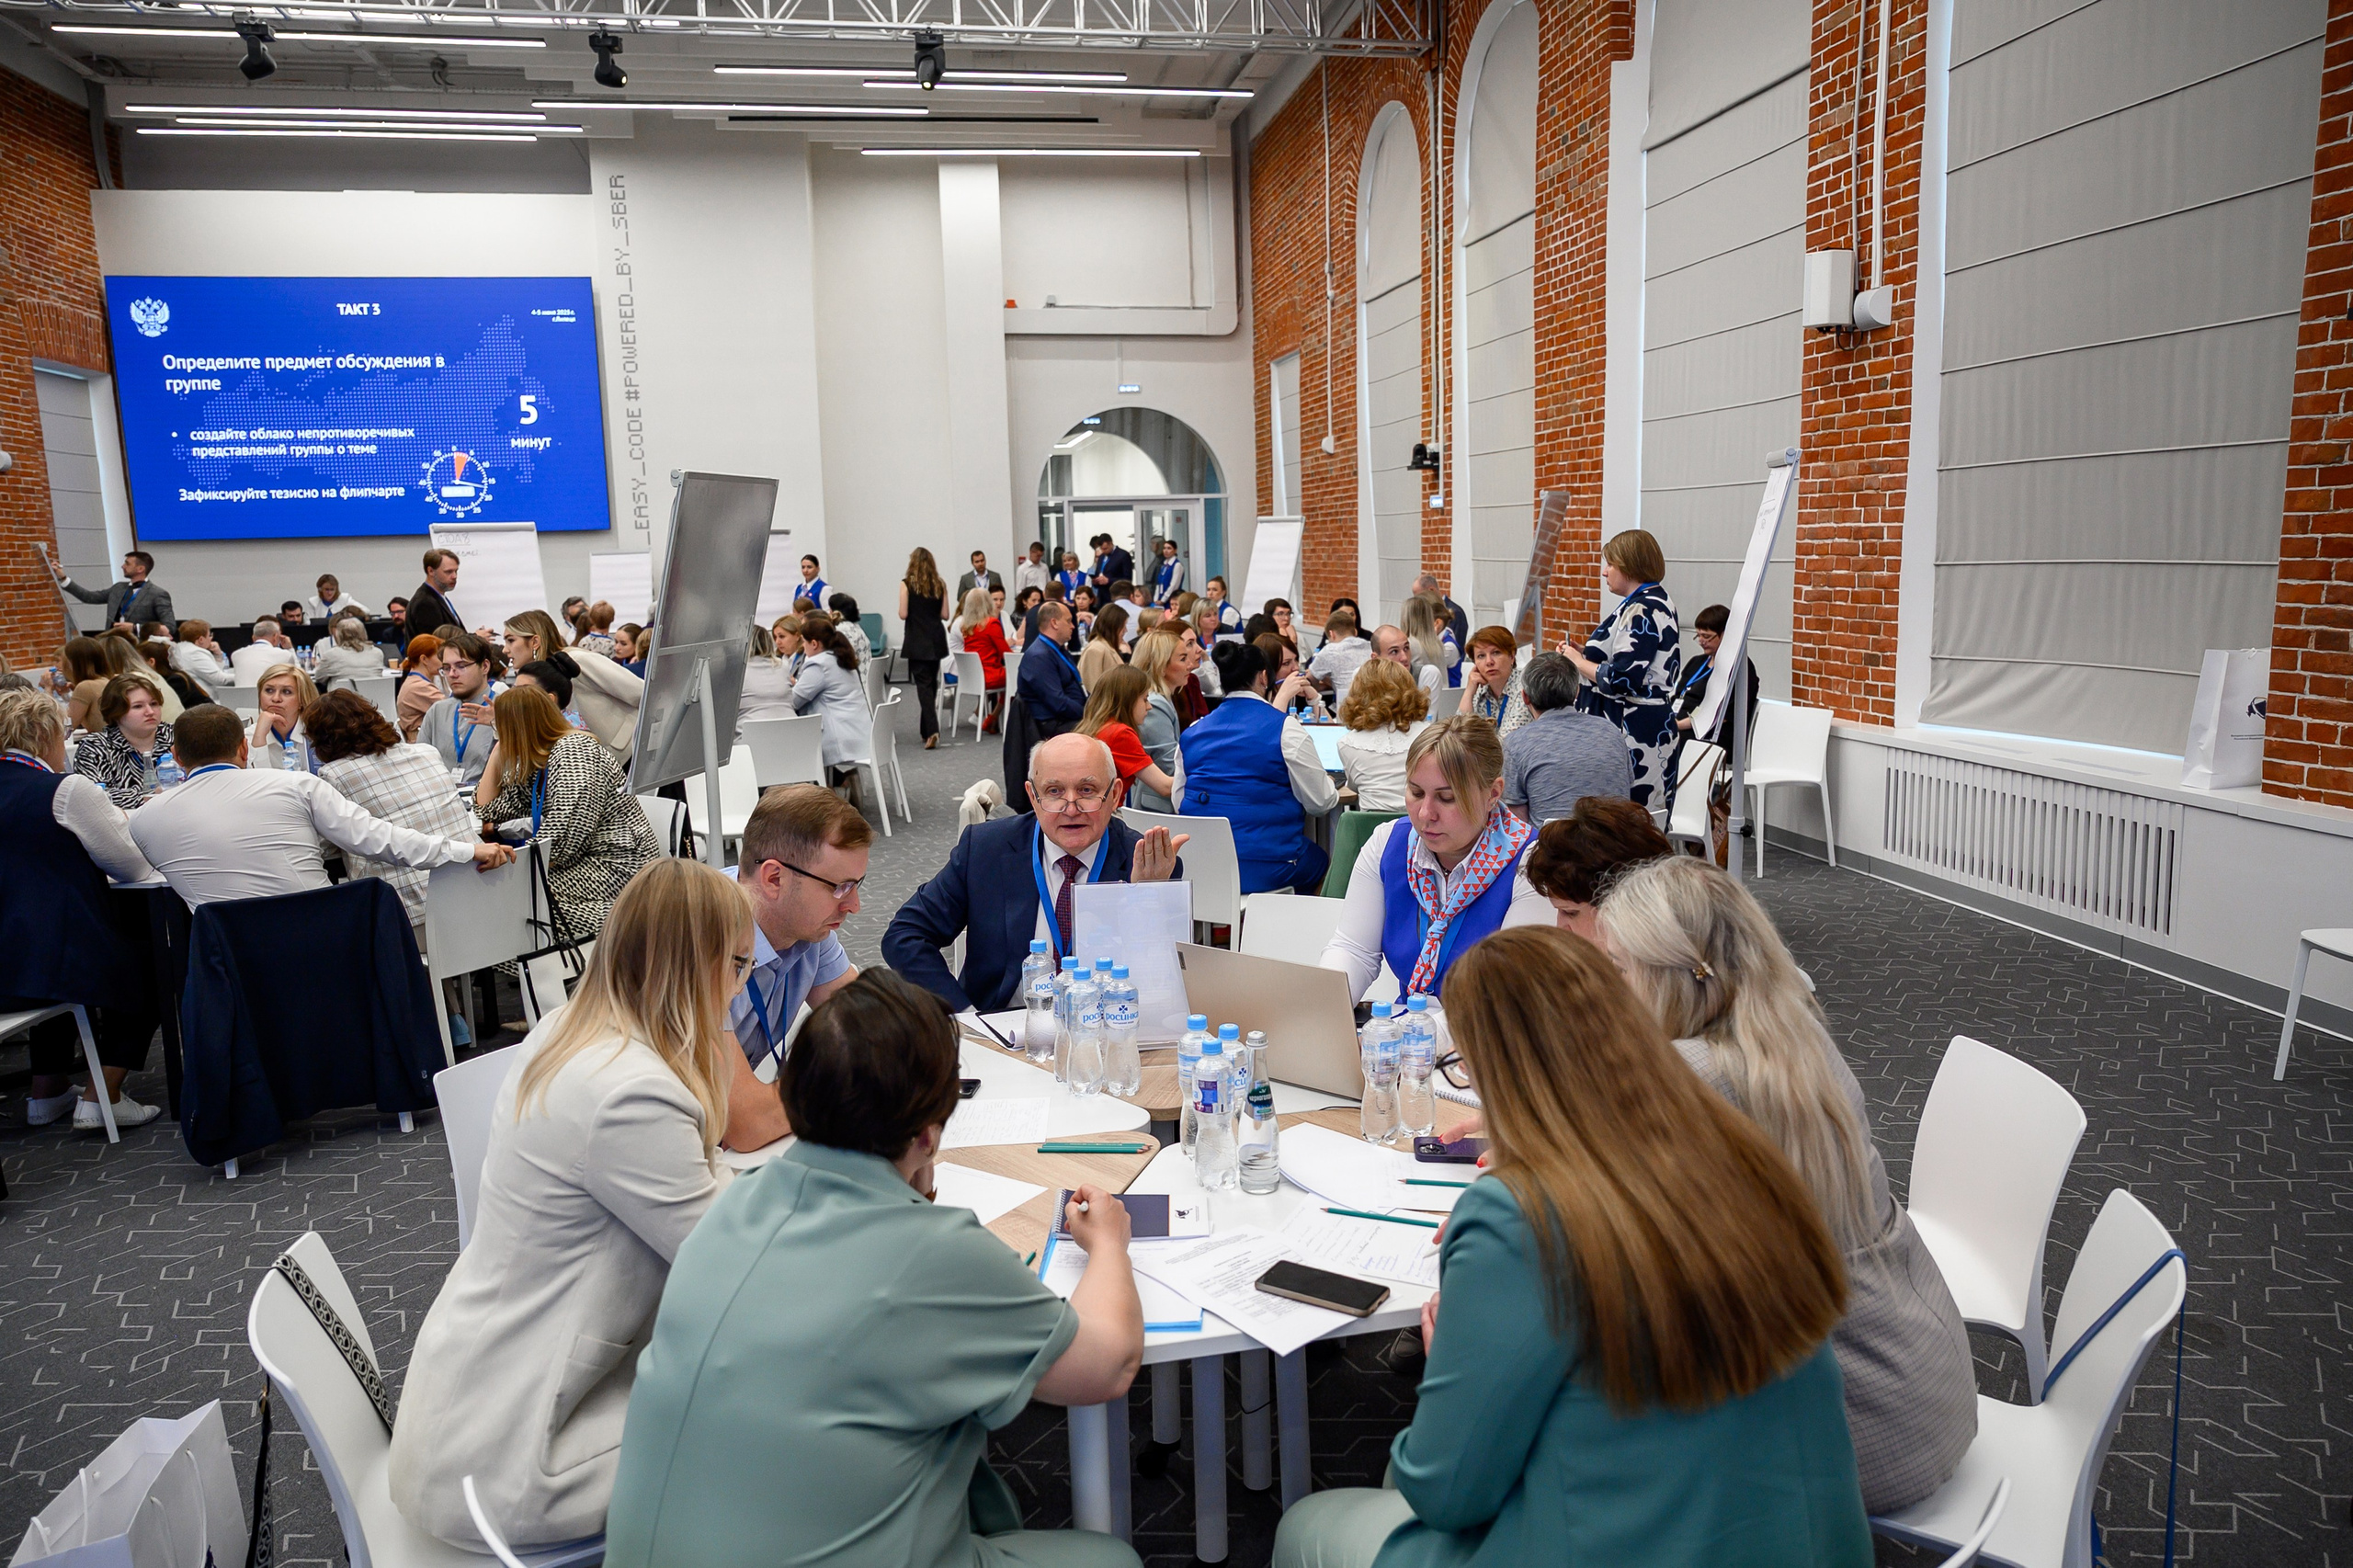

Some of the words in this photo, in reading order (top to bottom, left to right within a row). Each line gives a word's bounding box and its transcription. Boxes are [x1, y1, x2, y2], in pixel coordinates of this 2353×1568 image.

[336, 302, 370, 315] ТАКТ
[372, 303, 381, 315] 3
[162, 354, 261, 372] Определите
[265, 355, 333, 372] предмет
[335, 353, 431, 371] обсуждения
[435, 356, 445, 368] в
[165, 378, 222, 394] группе
[519, 394, 539, 425] 5
[189, 427, 247, 442] создайте
[249, 427, 294, 440] облако
[297, 427, 415, 441] непротиворечивых
[192, 443, 287, 459] представлений
[290, 444, 334, 458] группы
[336, 446, 345, 455] о
[347, 444, 377, 454] теме
[510, 437, 552, 450] минут
[178, 487, 267, 503] Зафиксируйте
[269, 488, 319, 499] тезисно
[322, 488, 337, 498] на
[339, 485, 405, 500] флипчарте
